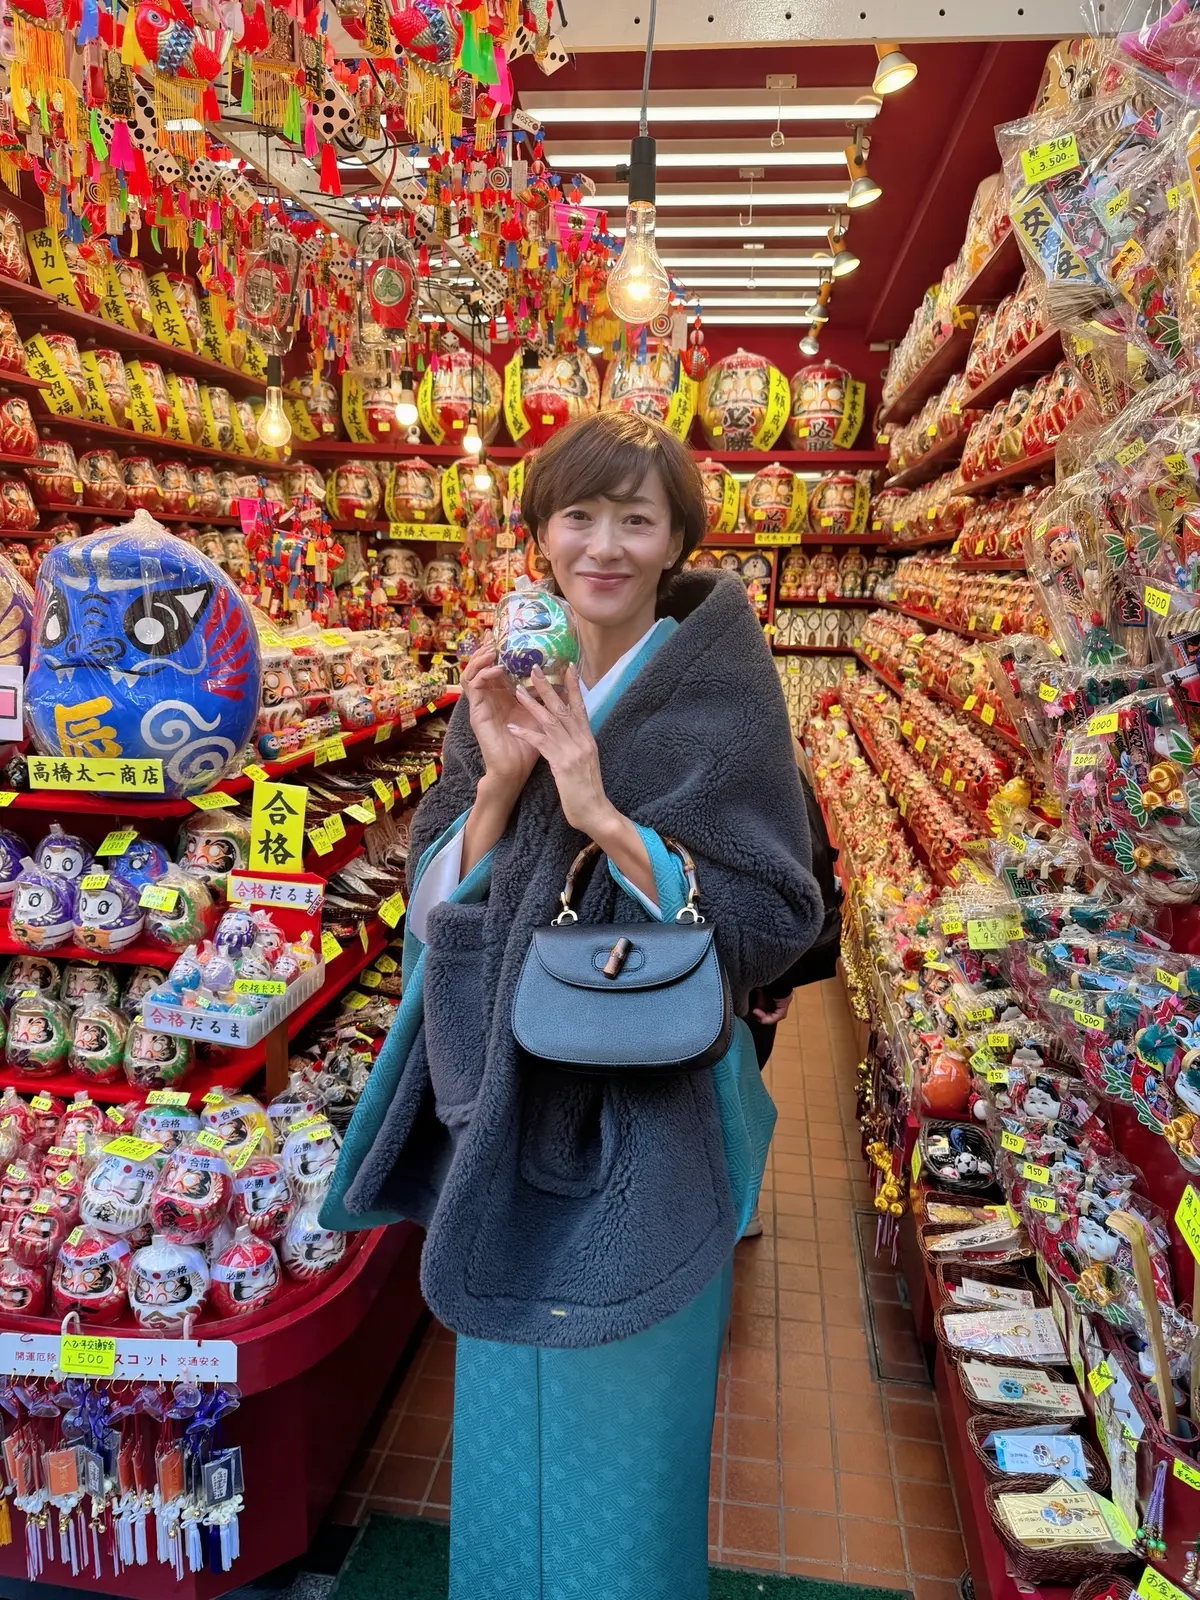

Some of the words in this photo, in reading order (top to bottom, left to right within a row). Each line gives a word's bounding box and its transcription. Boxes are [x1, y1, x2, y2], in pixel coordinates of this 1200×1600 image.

[24, 341, 74, 416] 開運招福
[1147, 592, 1167, 610] 2500
[54, 696, 123, 758] 辰
[33, 760, 160, 786] 高橋太一商店
[257, 790, 300, 867] 合格
[235, 882, 314, 904] 合格だるま
[971, 1009, 987, 1018] 850
[150, 1008, 241, 1039] 合格だるま
[992, 1035, 1005, 1044] 850
[220, 1107, 240, 1120] 合格
[161, 1118, 181, 1128] 合格
[1003, 1134, 1018, 1146] 950
[190, 1157, 210, 1168] 合格
[135, 1168, 155, 1180] 合格
[1028, 1165, 1043, 1176] 950
[244, 1179, 264, 1189] 必勝
[1033, 1198, 1048, 1208] 950
[88, 1252, 109, 1265] 合格
[166, 1265, 188, 1278] 合格
[226, 1270, 246, 1280] 必勝
[15, 1351, 57, 1363] 開運厄除
[177, 1356, 220, 1366] 交通安全
